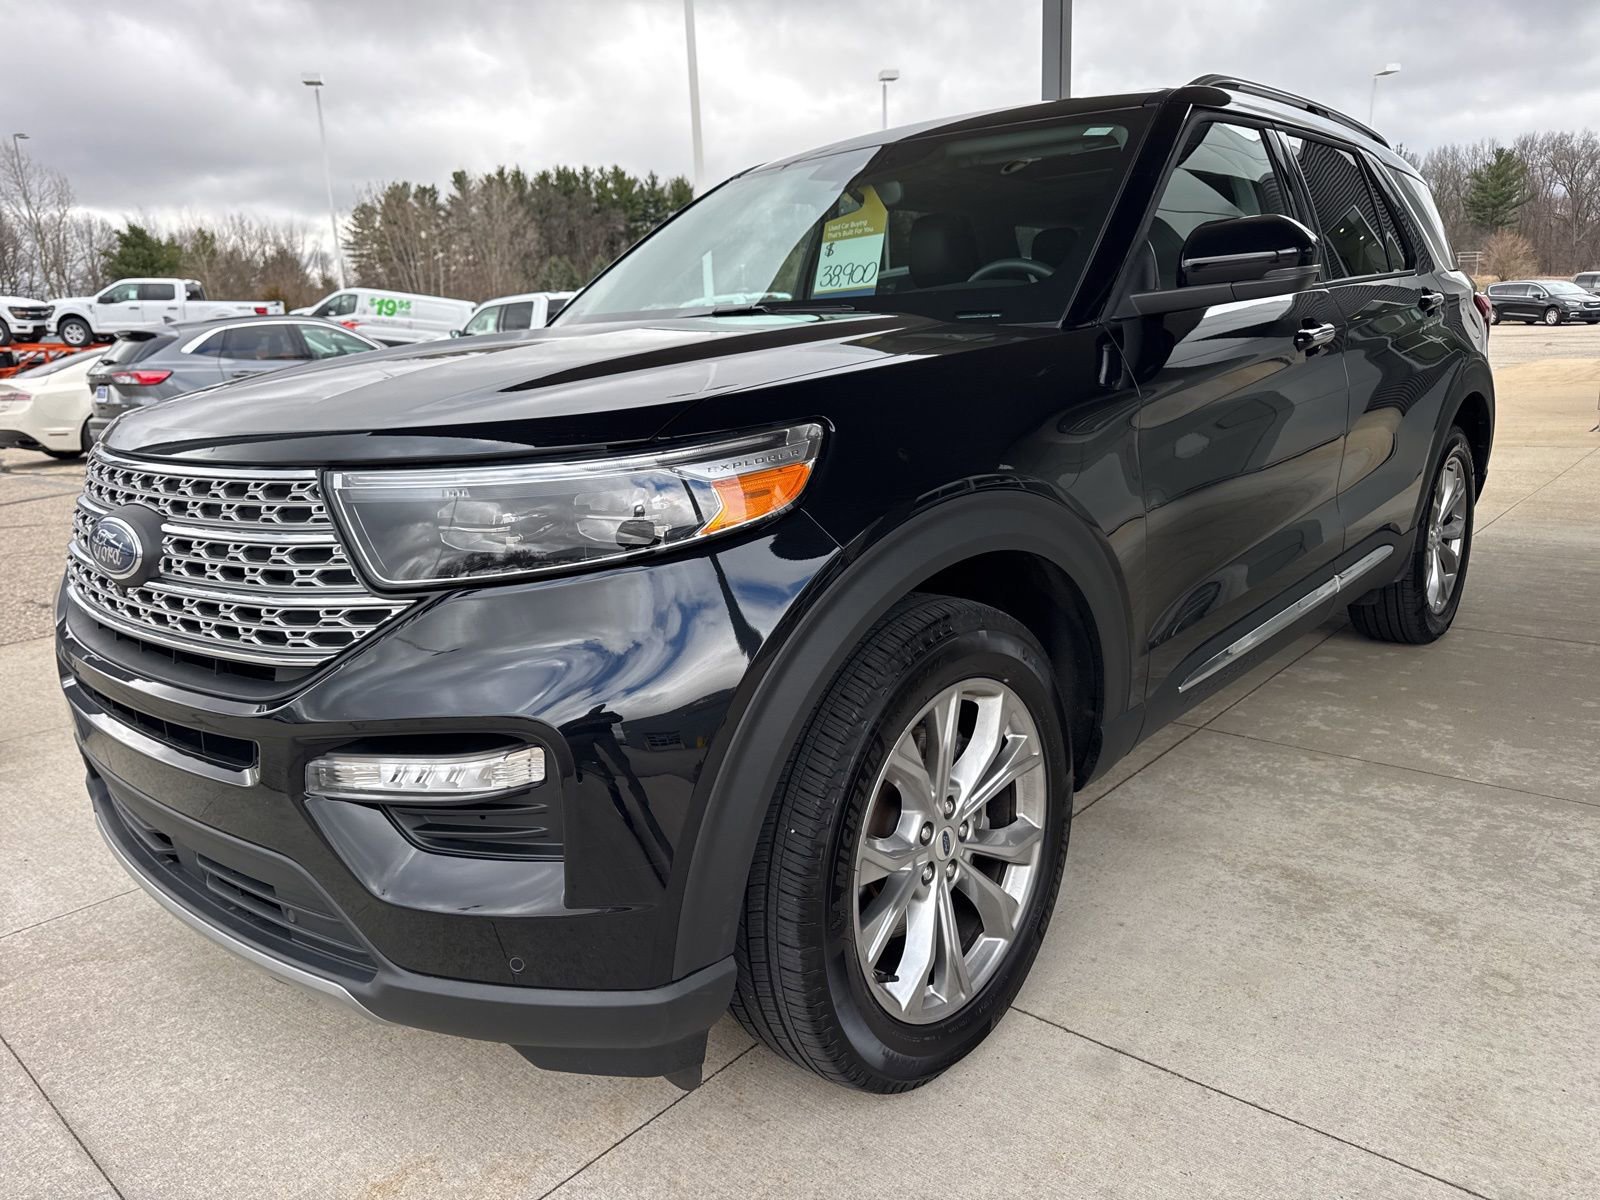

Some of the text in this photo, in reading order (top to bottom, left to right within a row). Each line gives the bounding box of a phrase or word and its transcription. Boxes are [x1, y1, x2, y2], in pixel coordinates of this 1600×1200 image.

[828, 220, 868, 232] Used Car Buying
[842, 230, 854, 238] Built
[825, 242, 834, 257] $
[819, 262, 878, 287] 38,900
[706, 449, 801, 474] EXPLORER
[834, 733, 885, 889] MICHELIN
